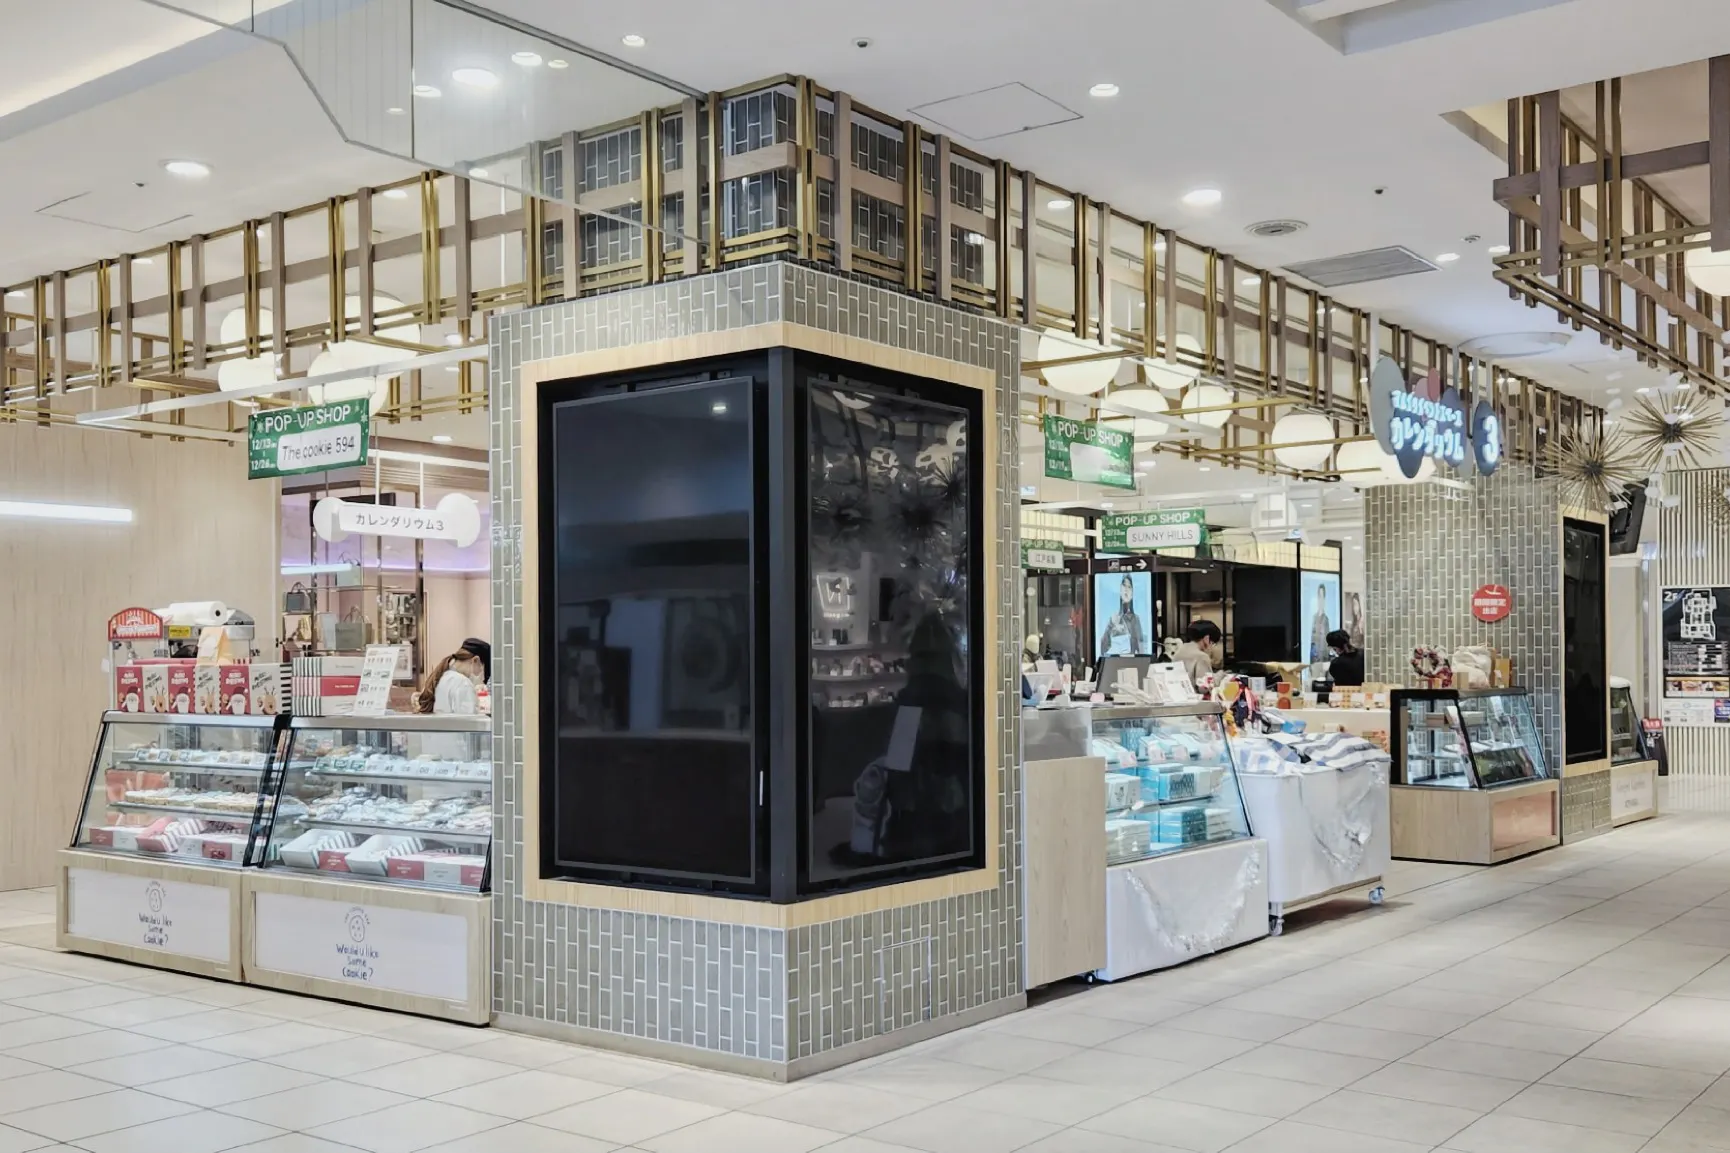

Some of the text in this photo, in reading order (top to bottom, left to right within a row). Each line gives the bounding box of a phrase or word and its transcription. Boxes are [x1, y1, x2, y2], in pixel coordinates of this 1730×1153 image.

[265, 404, 351, 433] POP-UP SHOP
[1057, 420, 1124, 448] POP-UP SHOP
[1482, 415, 1499, 463] 3
[282, 435, 356, 461] The cookie 594
[355, 513, 444, 531] カレンダリウム3
[1115, 512, 1191, 527] POP-UP SHOP
[1132, 529, 1194, 543] SUNNY HILLS
